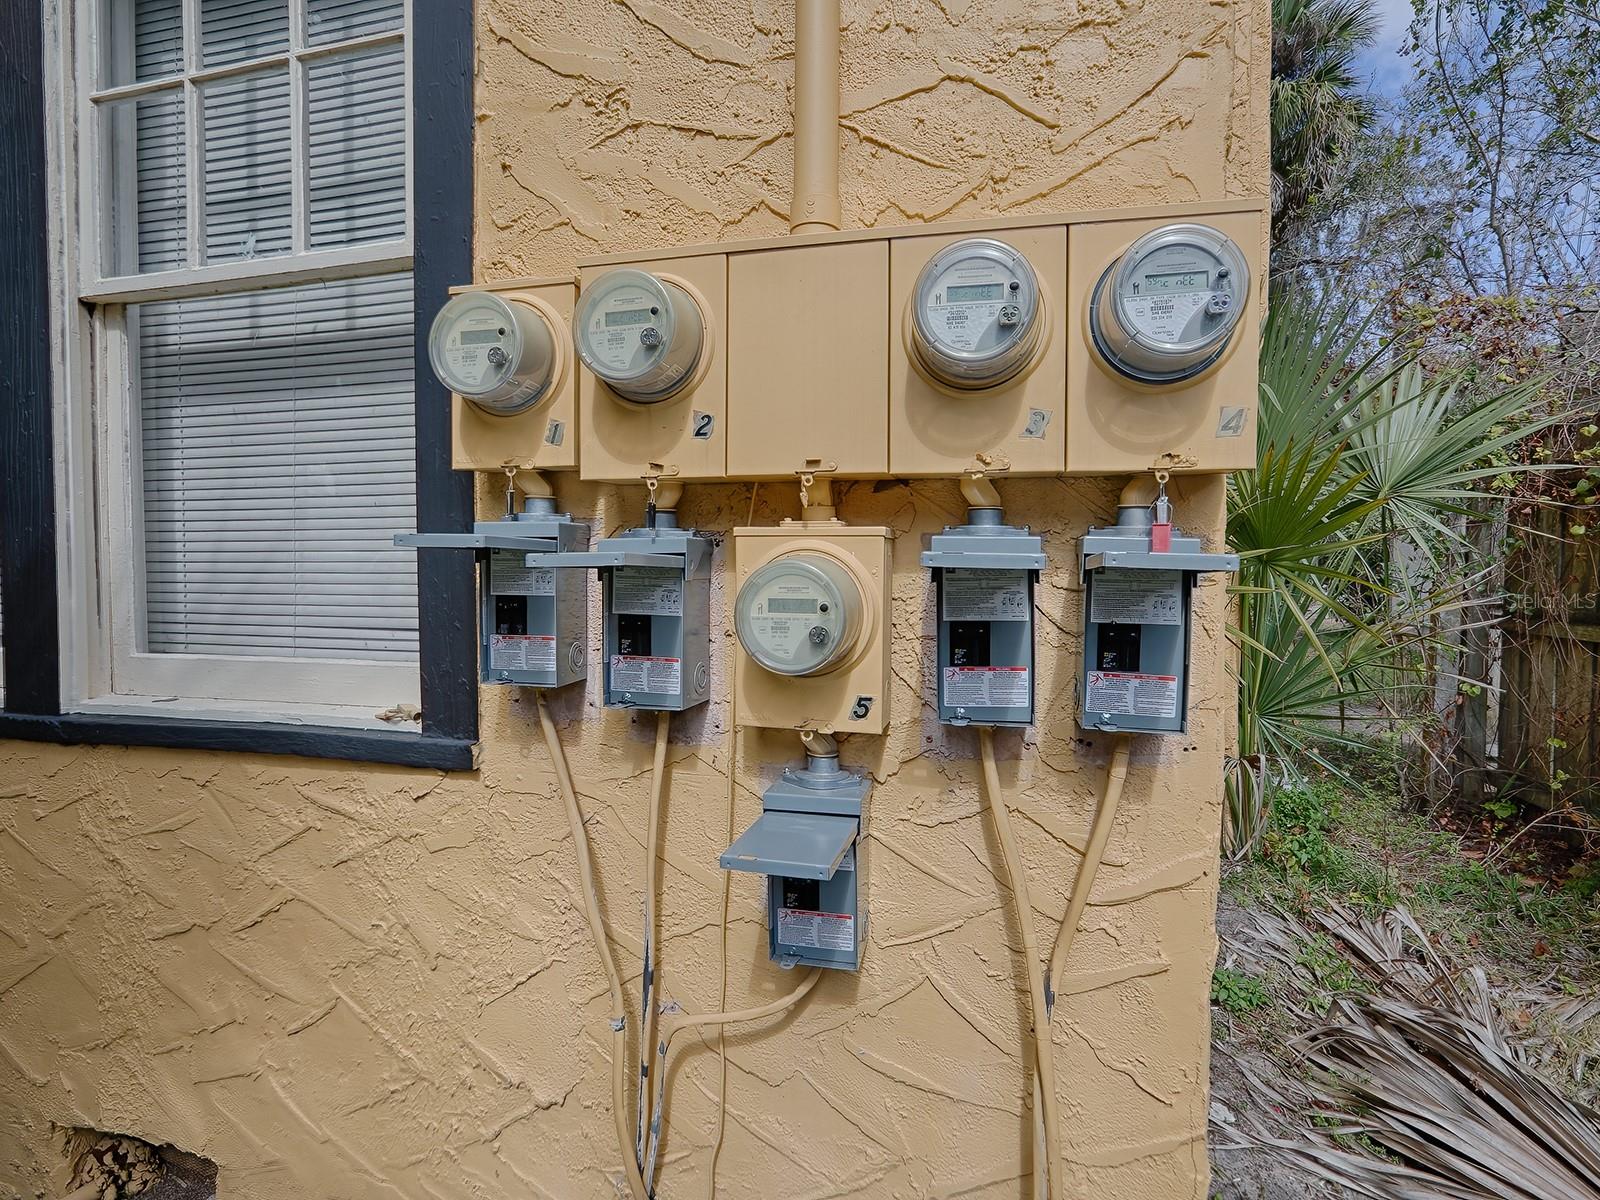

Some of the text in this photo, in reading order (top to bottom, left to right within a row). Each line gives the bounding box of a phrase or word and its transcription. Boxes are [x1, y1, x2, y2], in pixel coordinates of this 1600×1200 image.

[694, 414, 713, 437] 2
[1025, 411, 1046, 436] 3
[1221, 408, 1245, 435] 4
[550, 423, 560, 444] 1
[853, 697, 873, 719] 5
